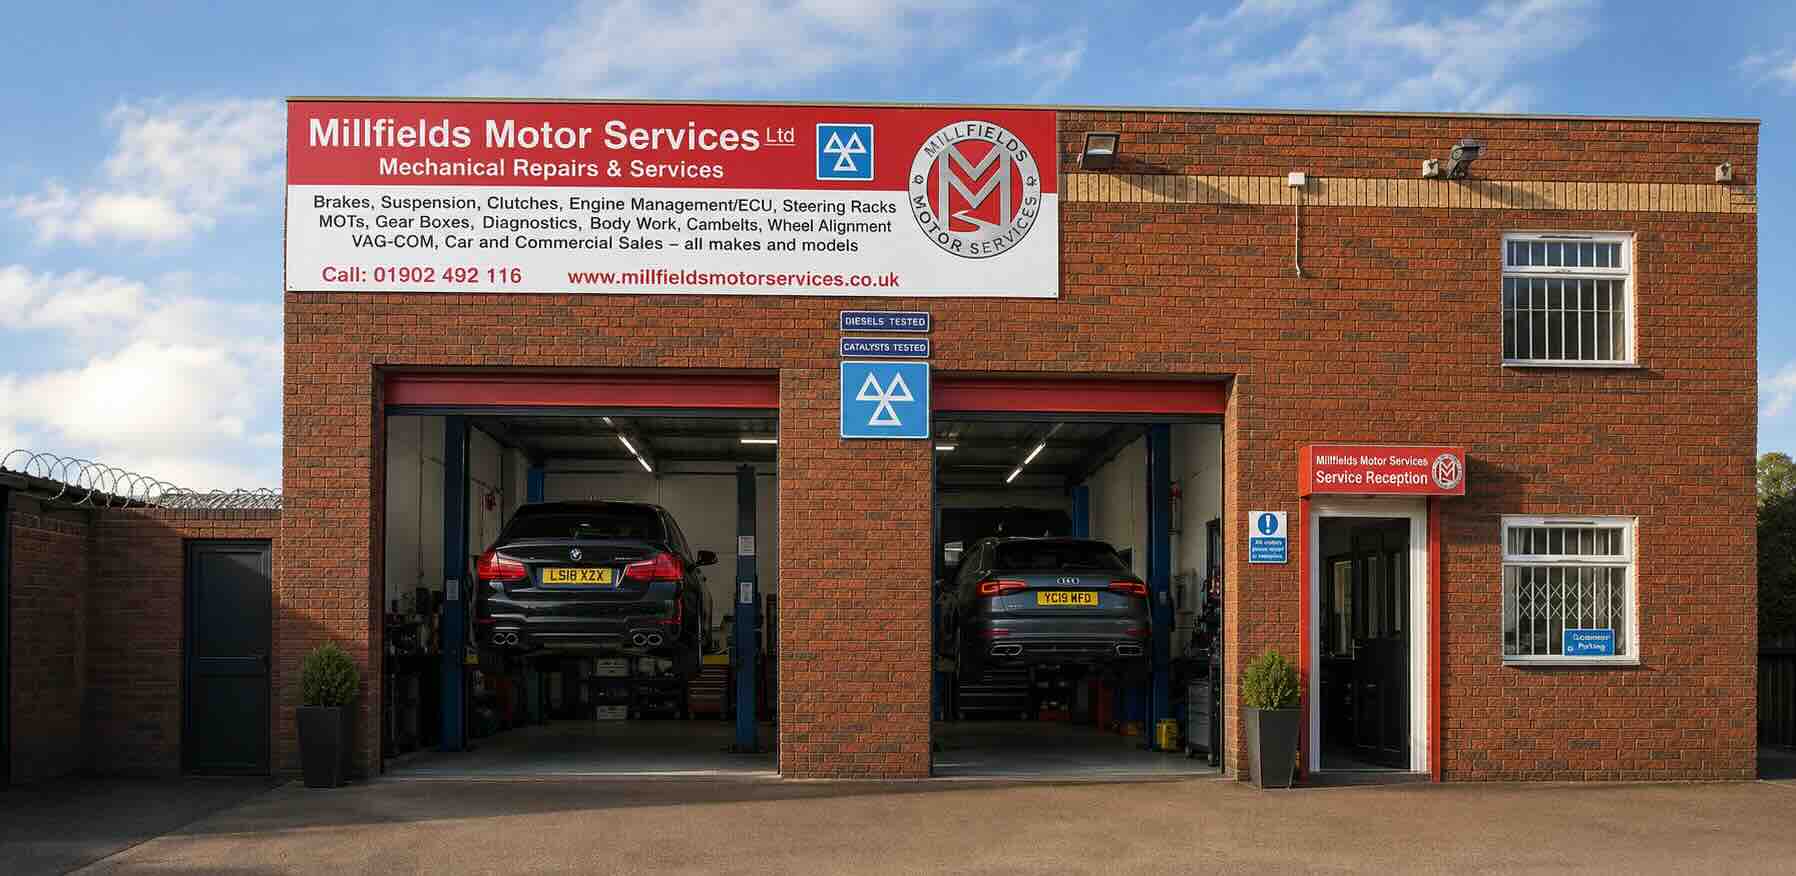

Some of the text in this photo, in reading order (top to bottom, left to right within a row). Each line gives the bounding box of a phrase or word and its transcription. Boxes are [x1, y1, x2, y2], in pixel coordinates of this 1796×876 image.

[309, 118, 795, 151] Millfields Motor Services Ltd
[924, 124, 1028, 162] MILLFIELDS
[379, 158, 724, 181] Mechanical Repairs & Services
[313, 195, 897, 220] Brakes, Suspension, Clutches, Engine Management/ECU, Steering Racks
[318, 214, 892, 237] MOTs, Gear Boxes, Diagnostics, Body Work, Cambelts, Wheel Alignment
[913, 195, 1037, 255] MOTOR SERVICES
[351, 234, 439, 250] VAG-COM,
[444, 235, 474, 249] Car
[479, 235, 509, 249] and
[515, 235, 613, 250] Commercial
[618, 236, 664, 251] Sales
[684, 237, 703, 251] all
[708, 237, 761, 251] makes
[767, 237, 796, 252] and
[802, 238, 859, 252] models
[321, 266, 522, 284] Call: 01902 492 116
[567, 268, 900, 289] www.millfieldsmotorservices.co.uk
[845, 316, 926, 327] DIESELS TESTED
[843, 343, 927, 353] CATALYSTS TESTED
[1316, 455, 1429, 467] Millfields Motor Services
[1316, 470, 1429, 487] Service Reception
